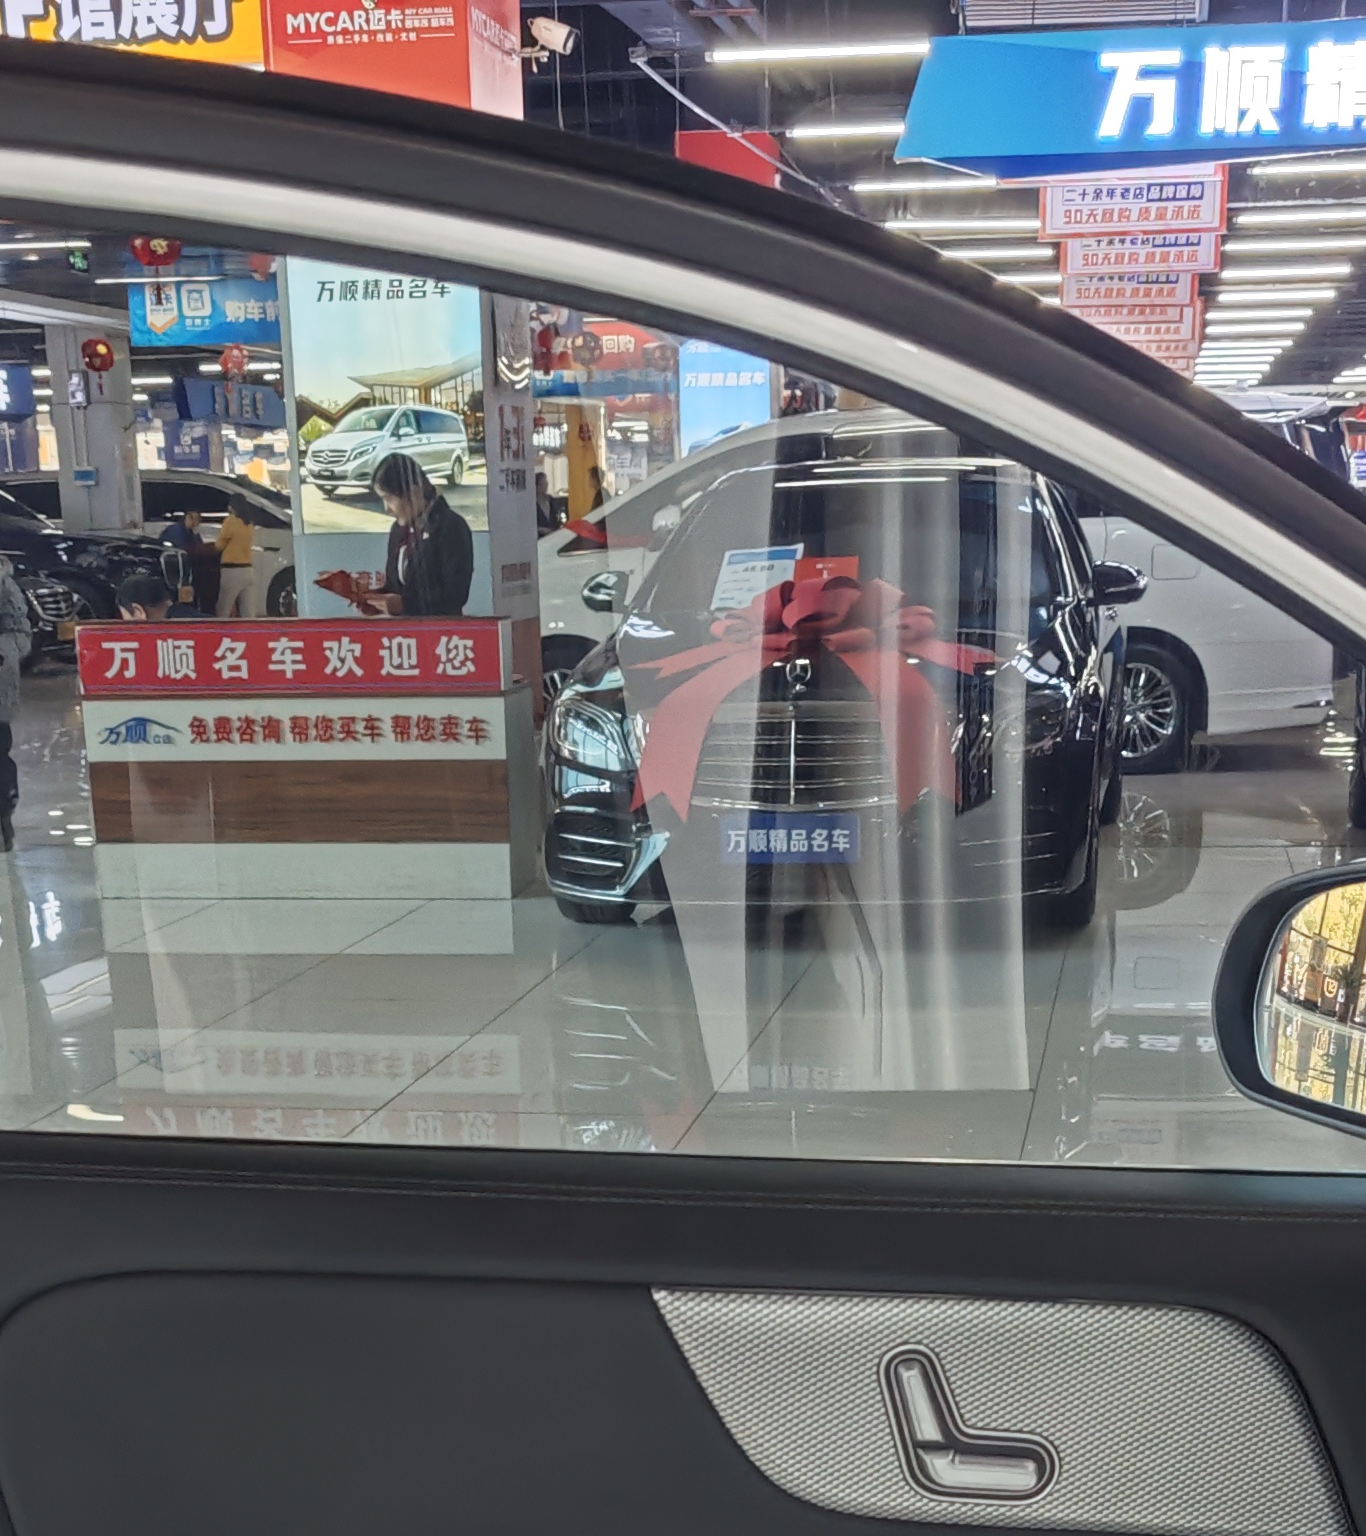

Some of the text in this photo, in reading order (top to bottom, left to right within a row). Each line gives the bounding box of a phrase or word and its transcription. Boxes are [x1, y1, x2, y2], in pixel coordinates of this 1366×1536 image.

[316, 278, 452, 303] 万顺精品名车
[100, 635, 476, 681] 万顺名车欢迎您
[188, 715, 283, 745] 免费咨询
[289, 715, 386, 744] 帮您买车
[390, 714, 491, 744] 帮您卖车
[726, 828, 851, 854] 万顺精品名车
